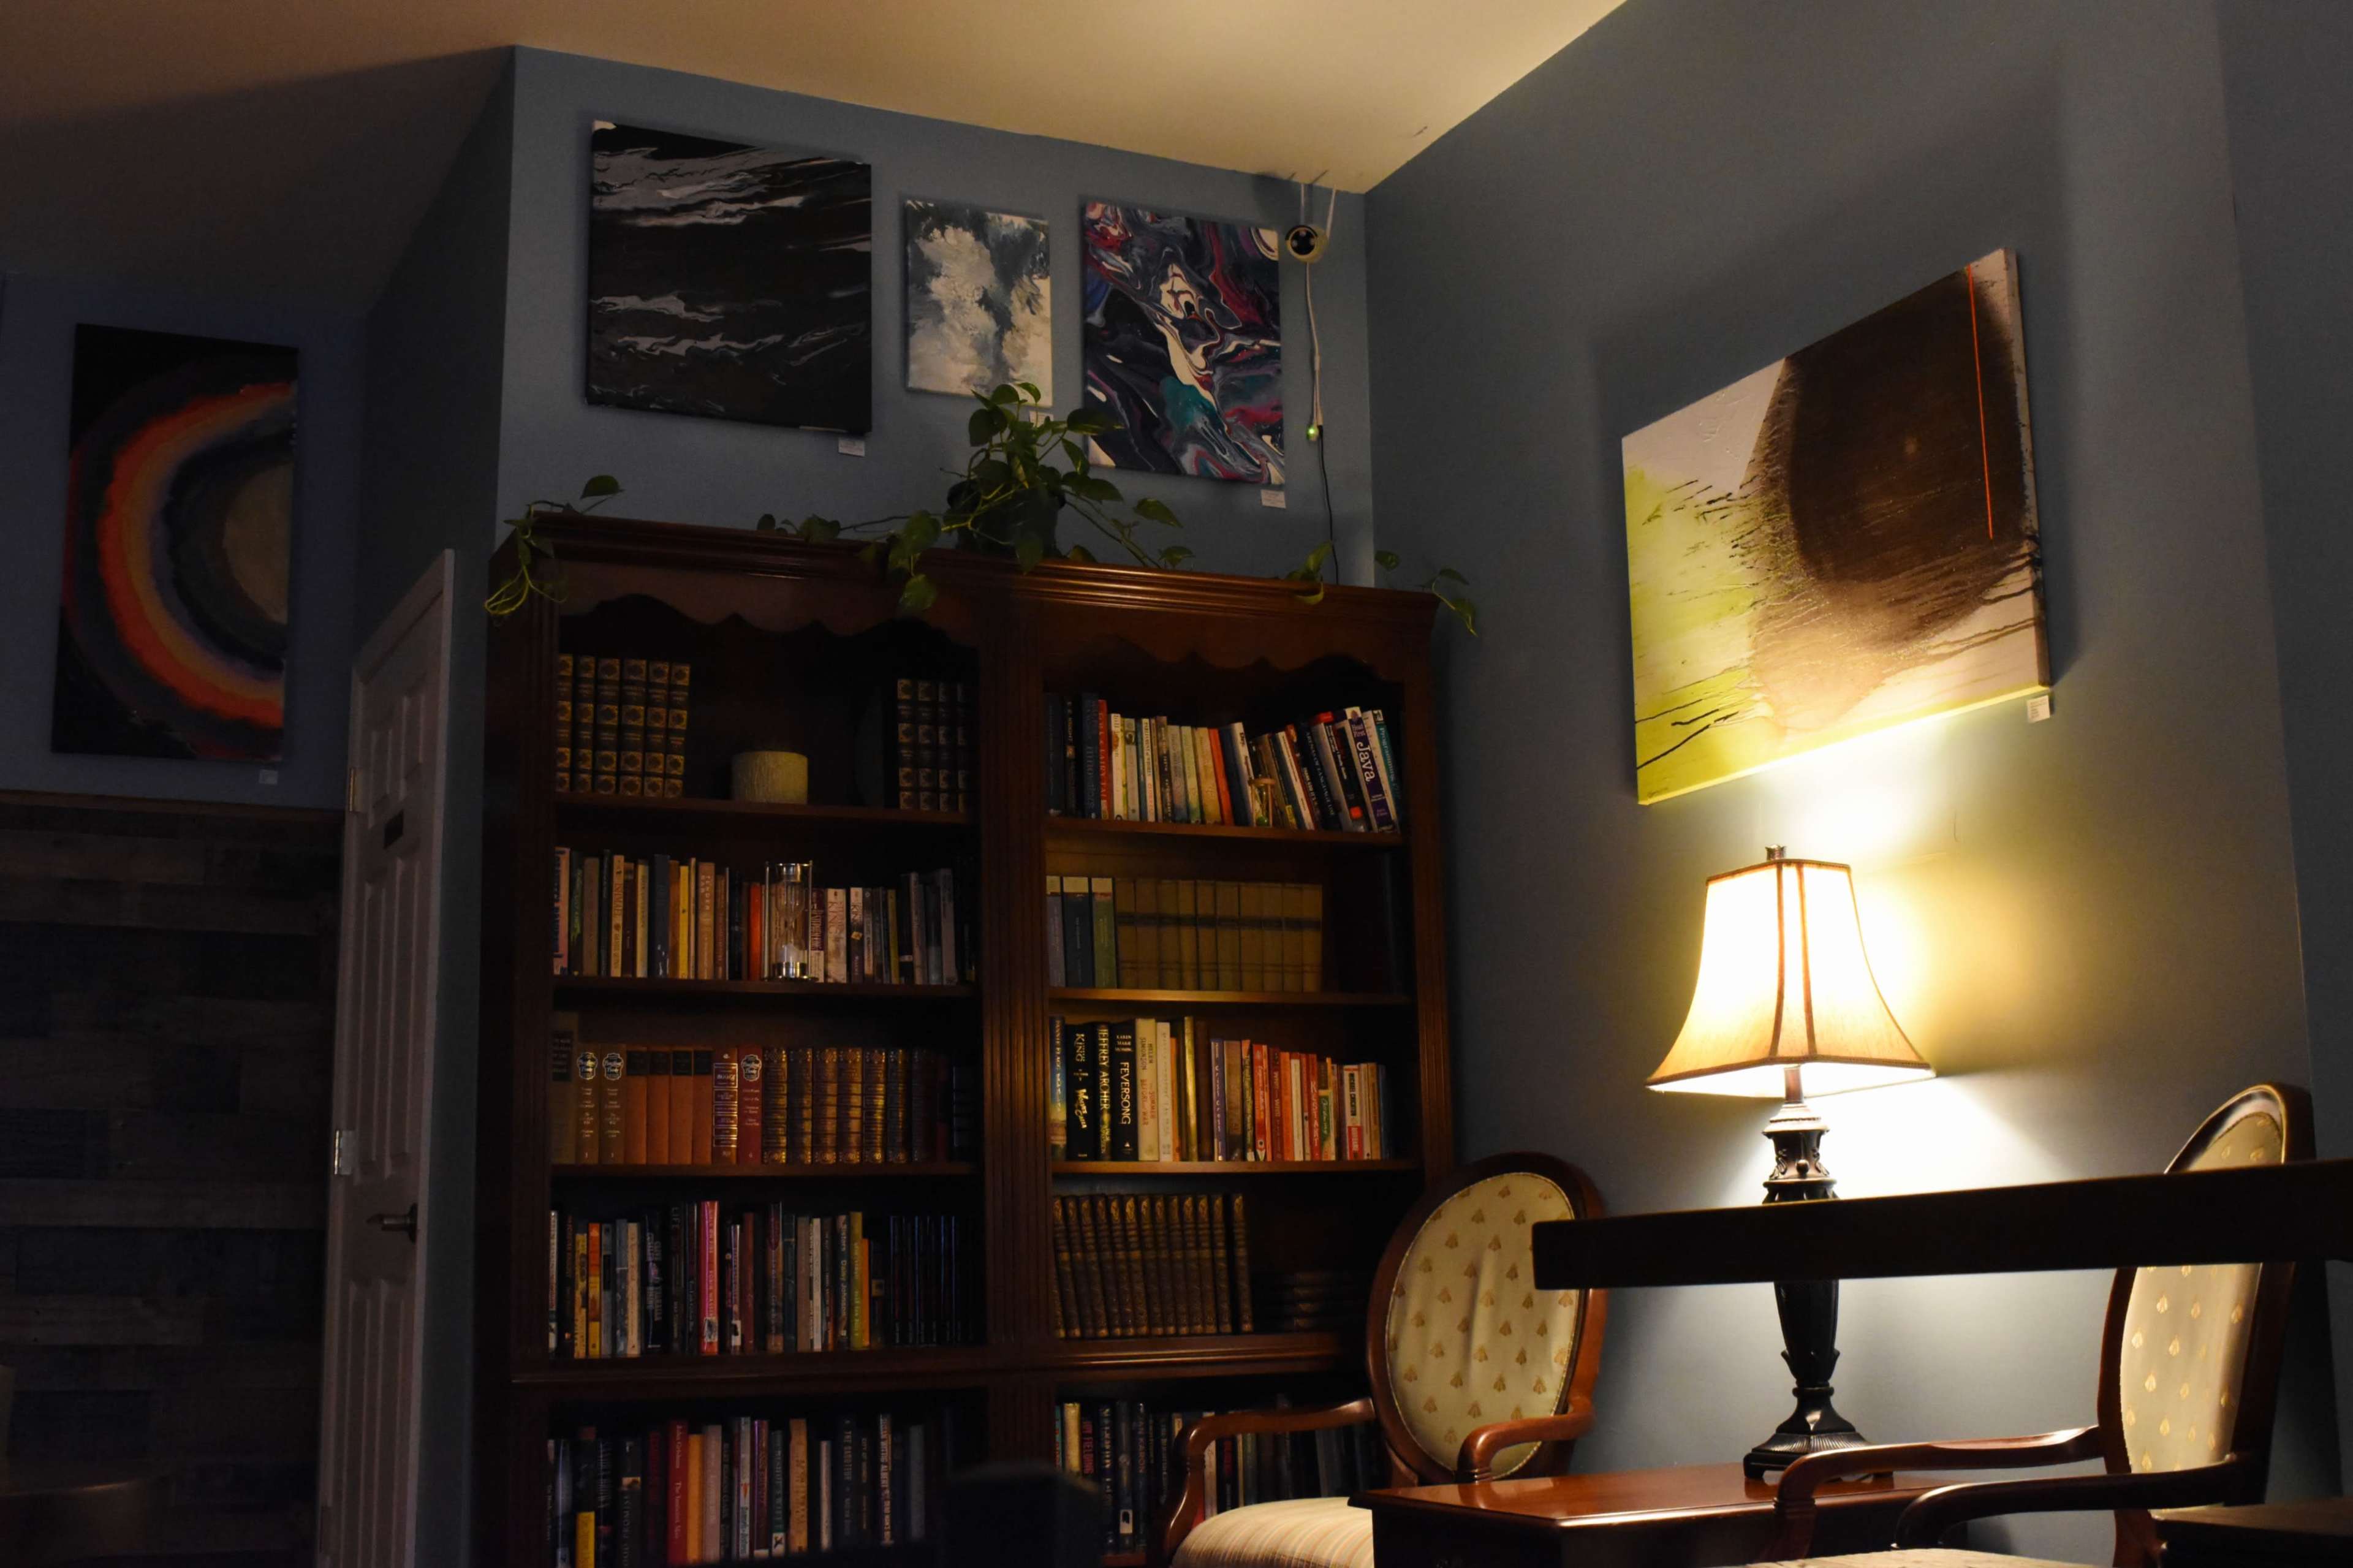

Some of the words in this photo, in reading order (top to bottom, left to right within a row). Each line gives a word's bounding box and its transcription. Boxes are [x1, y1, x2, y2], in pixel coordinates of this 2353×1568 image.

[1356, 741, 1376, 782] Java
[1380, 727, 1395, 782] Programming
[828, 902, 839, 933] KING
[1074, 1033, 1086, 1062] KING
[1097, 1029, 1110, 1067] JEFFREY
[1099, 1070, 1111, 1110] ARCHER
[1119, 1062, 1132, 1125] FEVERSONG
[671, 1206, 680, 1230] LIFE
